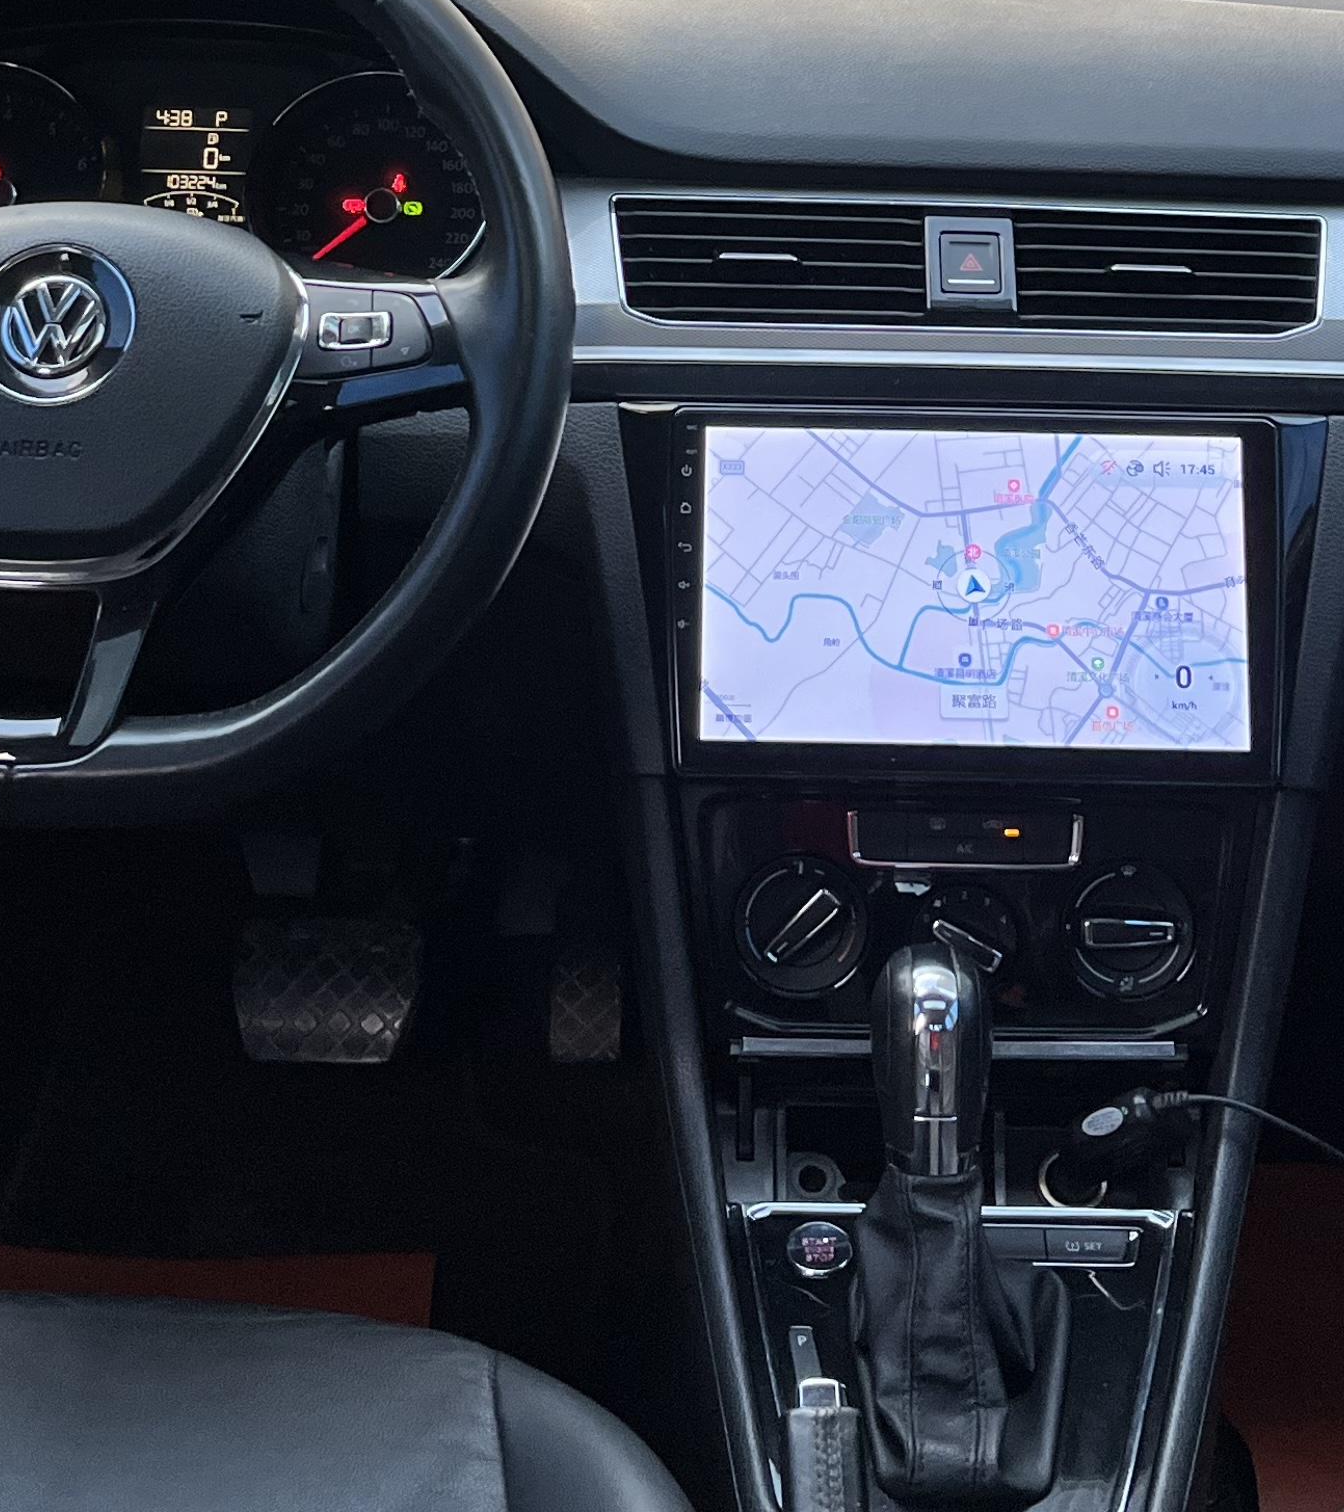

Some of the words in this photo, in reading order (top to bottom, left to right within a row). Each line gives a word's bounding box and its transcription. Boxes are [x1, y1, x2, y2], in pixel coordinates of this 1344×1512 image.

[156, 110, 193, 127] 4:38
[216, 111, 228, 127] P
[167, 174, 216, 189] 103224
[1181, 464, 1215, 475] 17:45
[1176, 665, 1192, 688] 0
[951, 694, 997, 709] 聚富路
[1171, 700, 1198, 711] km/h
[1084, 1242, 1103, 1251] SET
